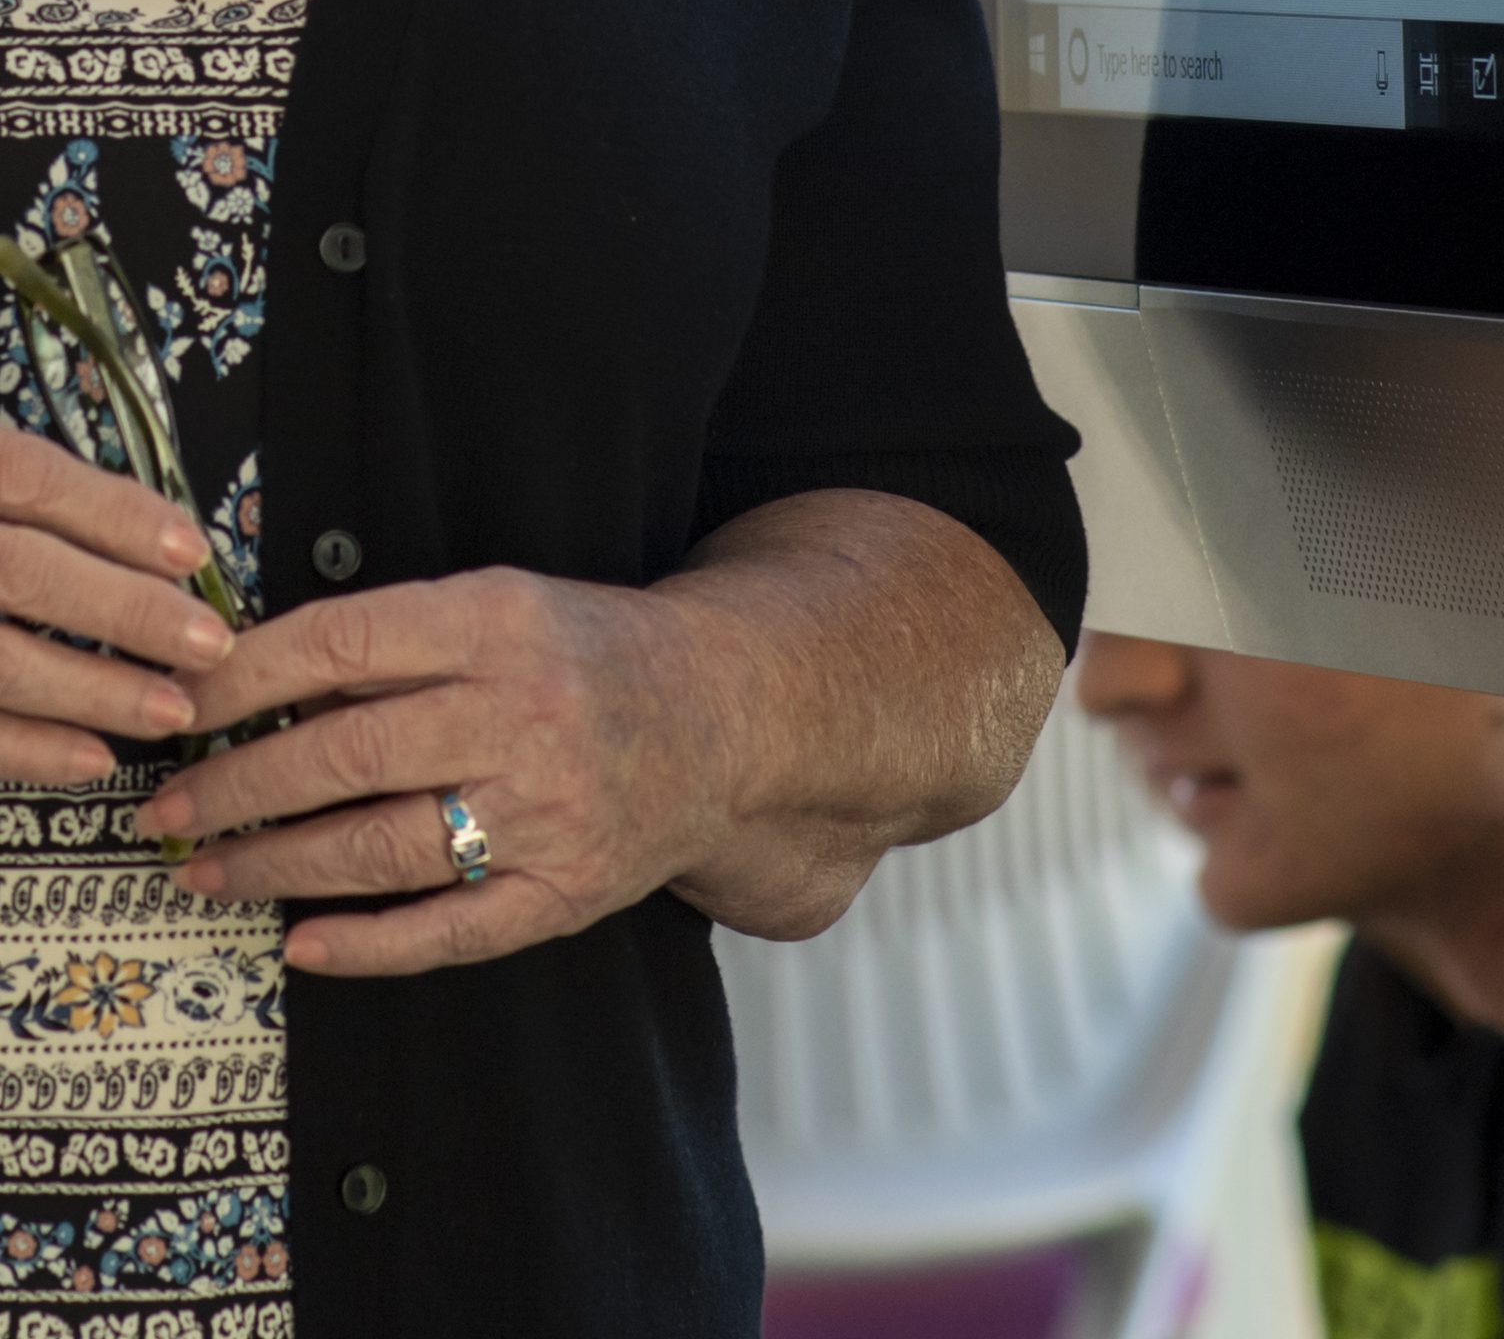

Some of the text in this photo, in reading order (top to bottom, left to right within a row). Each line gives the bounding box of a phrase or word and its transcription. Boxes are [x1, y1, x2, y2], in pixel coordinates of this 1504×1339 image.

[1097, 43, 1224, 82] Type here to search
